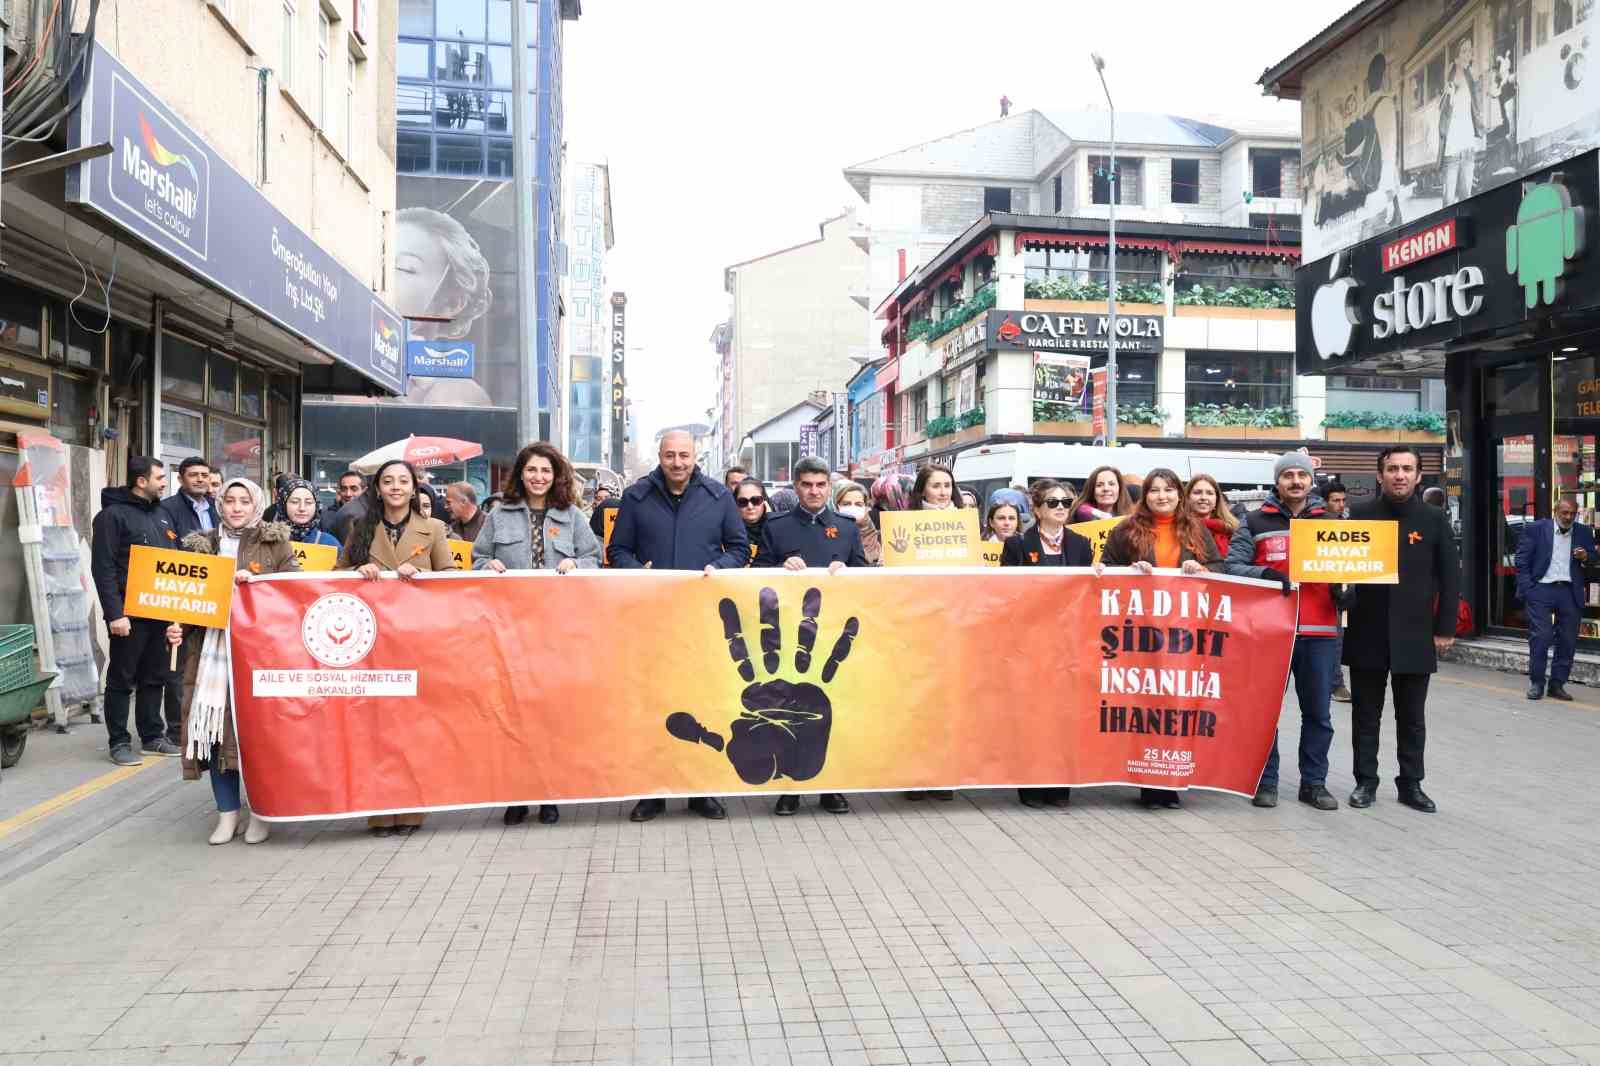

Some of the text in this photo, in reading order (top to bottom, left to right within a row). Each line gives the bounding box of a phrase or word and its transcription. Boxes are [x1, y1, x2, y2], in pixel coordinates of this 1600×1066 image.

[123, 136, 193, 219] Marshall
[164, 211, 191, 239] colour
[1388, 224, 1450, 267] KENAN
[1373, 265, 1484, 339] store
[1020, 314, 1161, 338] CAFE MOLA
[1080, 340, 1141, 350] RESTARANT
[414, 355, 464, 367] Marshall
[914, 520, 965, 532] KADINA
[913, 534, 967, 548] ŞİDDETE
[1317, 531, 1371, 542] KADES
[1316, 546, 1369, 558] HAYAT
[155, 560, 208, 579] KADES
[1302, 559, 1384, 572] KURTARIR
[154, 578, 207, 596] HAYAT
[138, 592, 218, 615] KURTARIR
[1100, 588, 1232, 622] KADINA
[259, 671, 412, 683] AİLE VE SOSYAL HİZMETLER
[308, 684, 366, 695] BAKANLIĞI
[1144, 748, 1158, 759] 25
